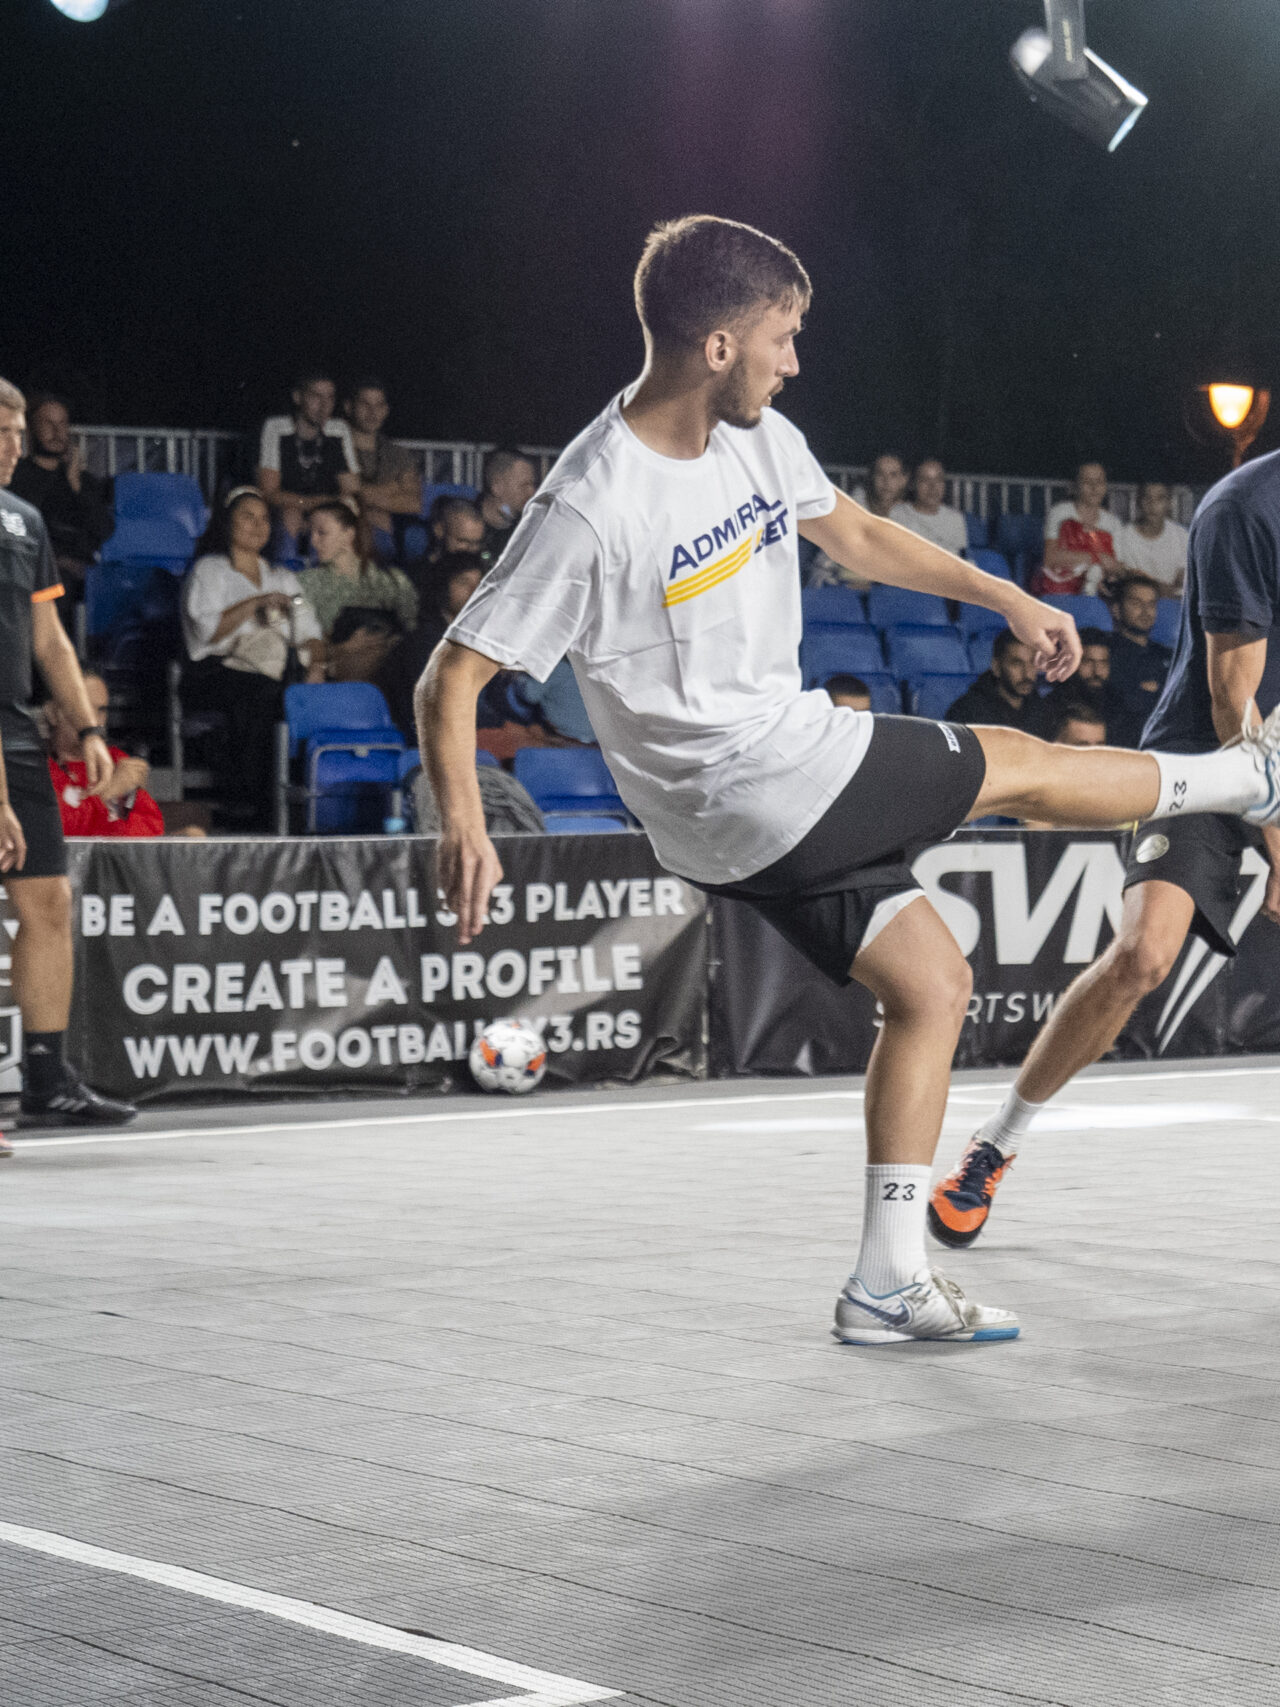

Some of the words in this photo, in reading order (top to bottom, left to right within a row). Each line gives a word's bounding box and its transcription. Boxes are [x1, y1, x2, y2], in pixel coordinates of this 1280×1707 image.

[669, 494, 782, 580] ADMIRAL
[754, 508, 788, 554] ET
[82, 895, 135, 937] BE
[147, 894, 185, 936] A
[200, 888, 427, 935] FOOTBALL
[526, 876, 686, 923] PLAYER
[123, 958, 348, 1015] CREATE
[365, 956, 408, 1005] A
[421, 944, 643, 1003] PROFILE
[123, 1010, 643, 1079] WWW.FOOTBAL3.RS
[883, 1182, 917, 1201] 23
